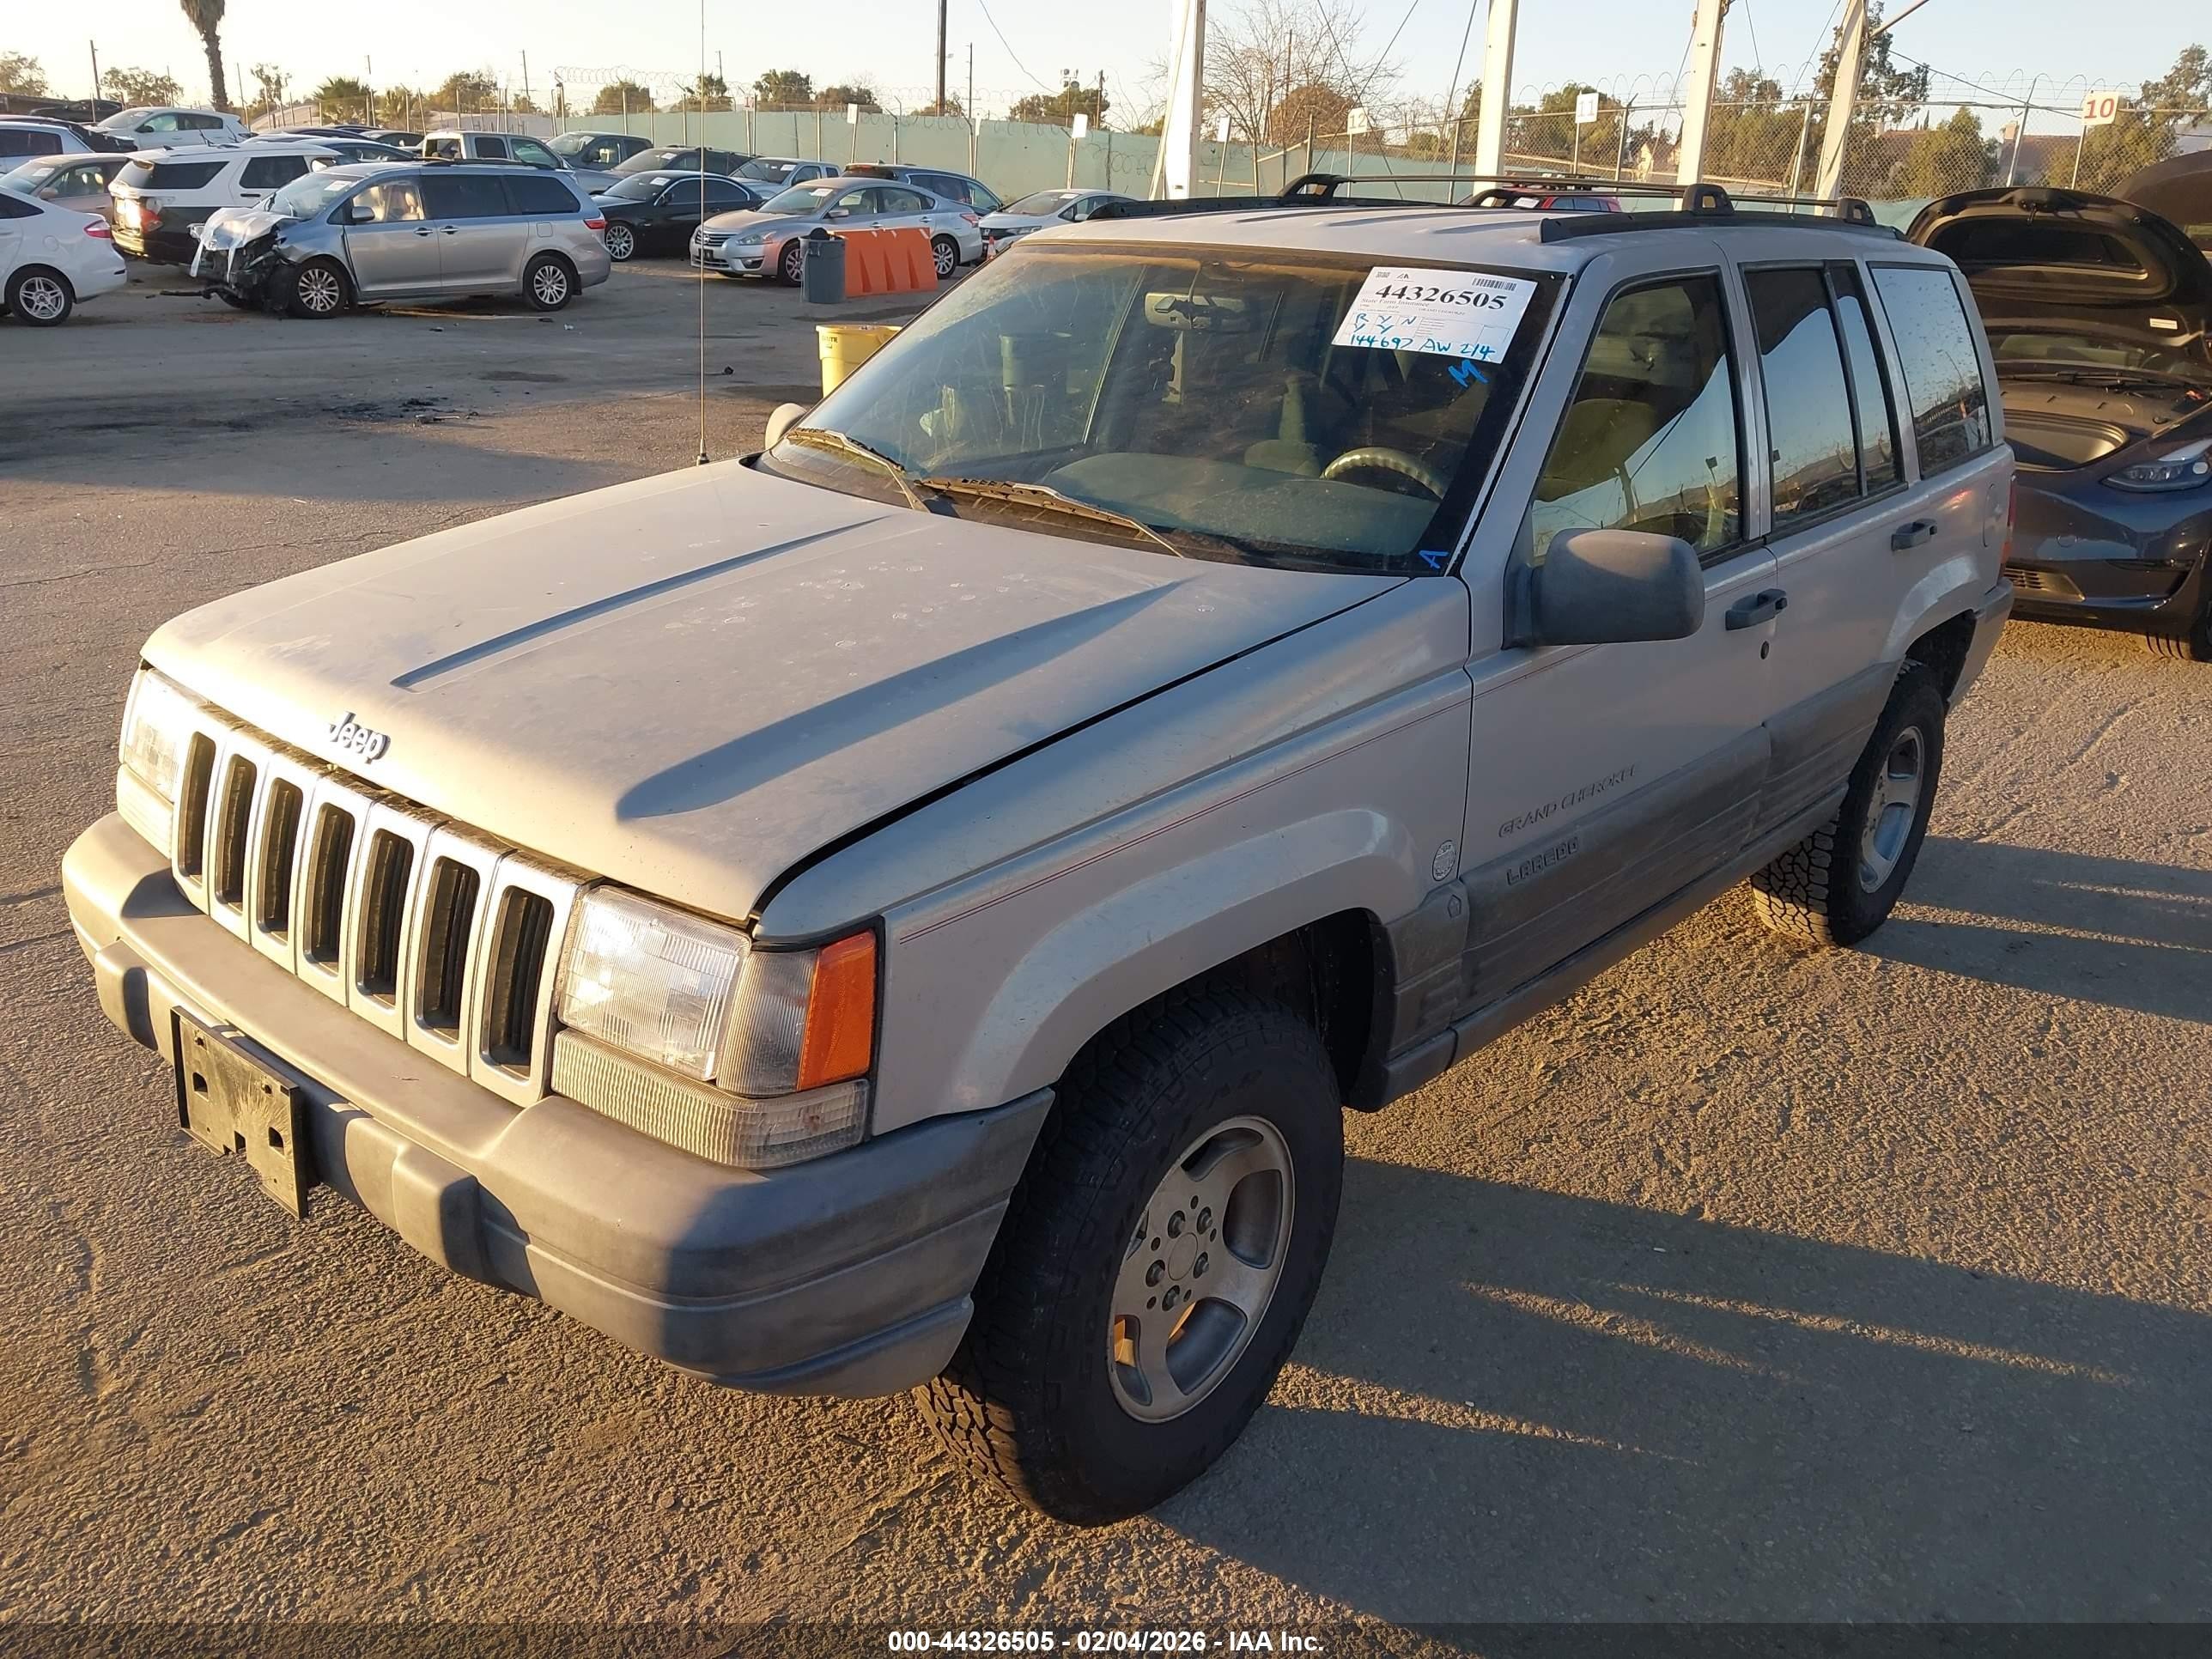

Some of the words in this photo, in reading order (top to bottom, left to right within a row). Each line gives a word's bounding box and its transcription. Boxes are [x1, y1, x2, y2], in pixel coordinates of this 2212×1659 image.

[2084, 98, 2115, 118] 10
[1349, 112, 1366, 129] 12
[1376, 285, 1508, 310] 44326505
[1379, 315, 1392, 324] Y
[1351, 334, 1413, 349] 144697
[1419, 338, 1451, 352] AW
[328, 710, 392, 765] Jeep
[1498, 803, 1559, 838] GRAND
[1560, 763, 1638, 811] CHEROKEE
[1506, 836, 1578, 886] LAREDO
